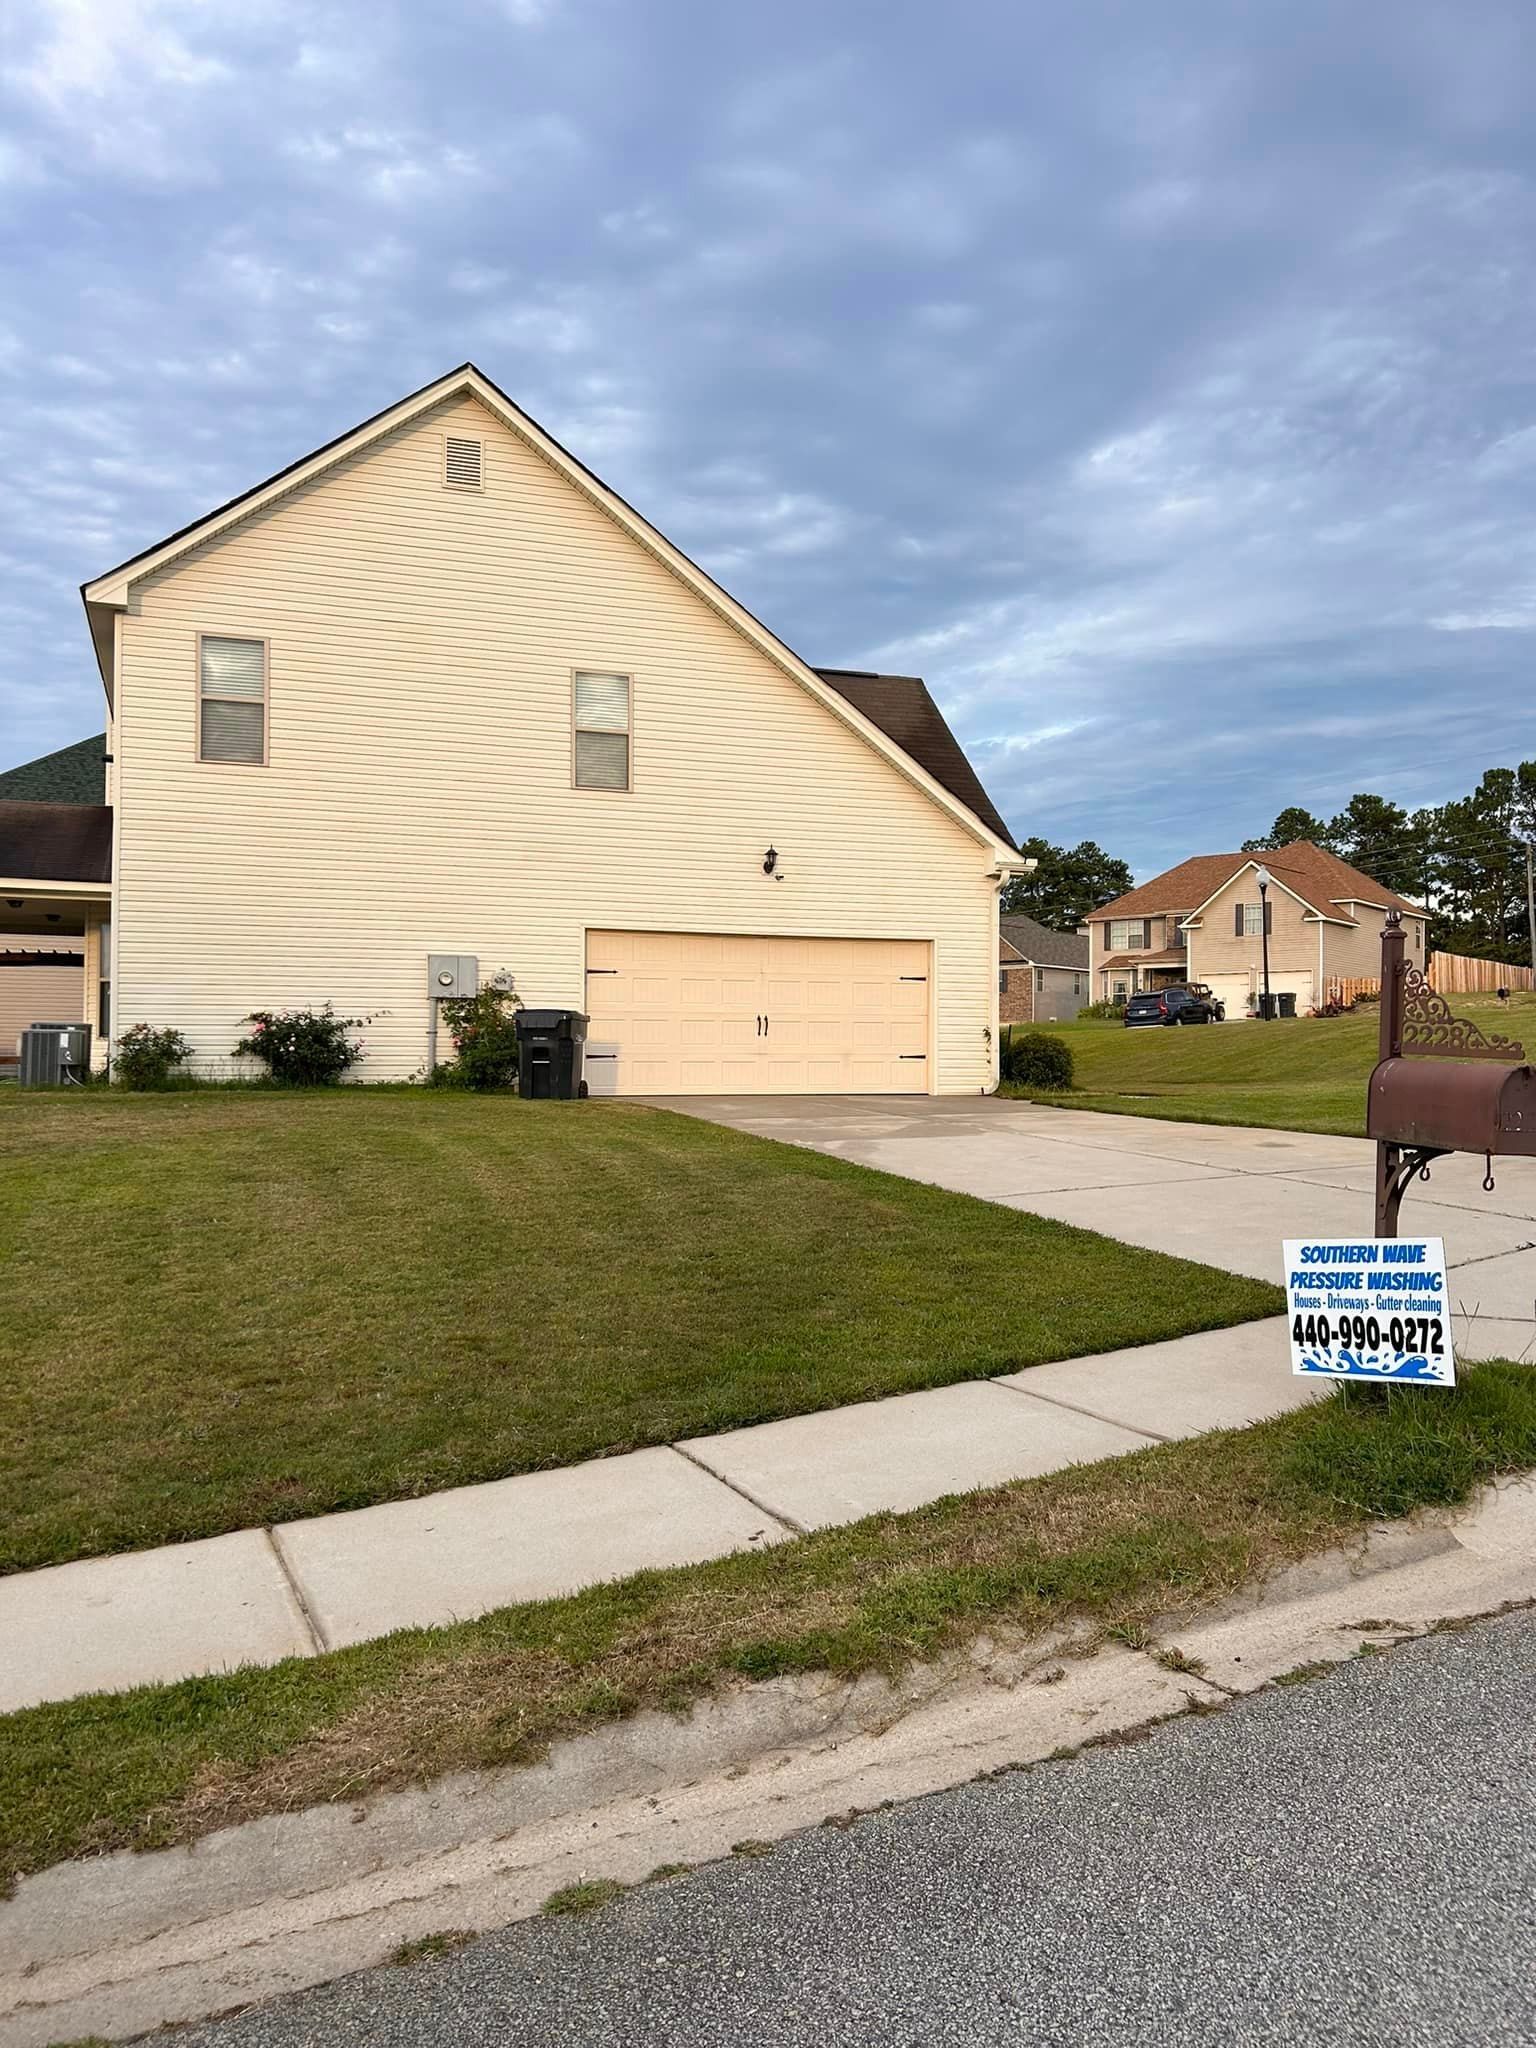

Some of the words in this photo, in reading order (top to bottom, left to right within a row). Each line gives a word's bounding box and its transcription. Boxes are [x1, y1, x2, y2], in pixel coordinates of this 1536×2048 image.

[1404, 1024, 1464, 1049] 2228
[1300, 1245, 1378, 1263] SOUTHERN
[1383, 1245, 1426, 1263] WAVE
[1290, 1272, 1364, 1289] PRESSURE
[1367, 1272, 1443, 1291] WASHING
[1294, 1293, 1321, 1309] Houses
[1327, 1293, 1369, 1313] Driveways
[1376, 1294, 1403, 1311] Gutter
[1404, 1295, 1442, 1316] cleaning
[1293, 1314, 1444, 1354] 440-990-0272
